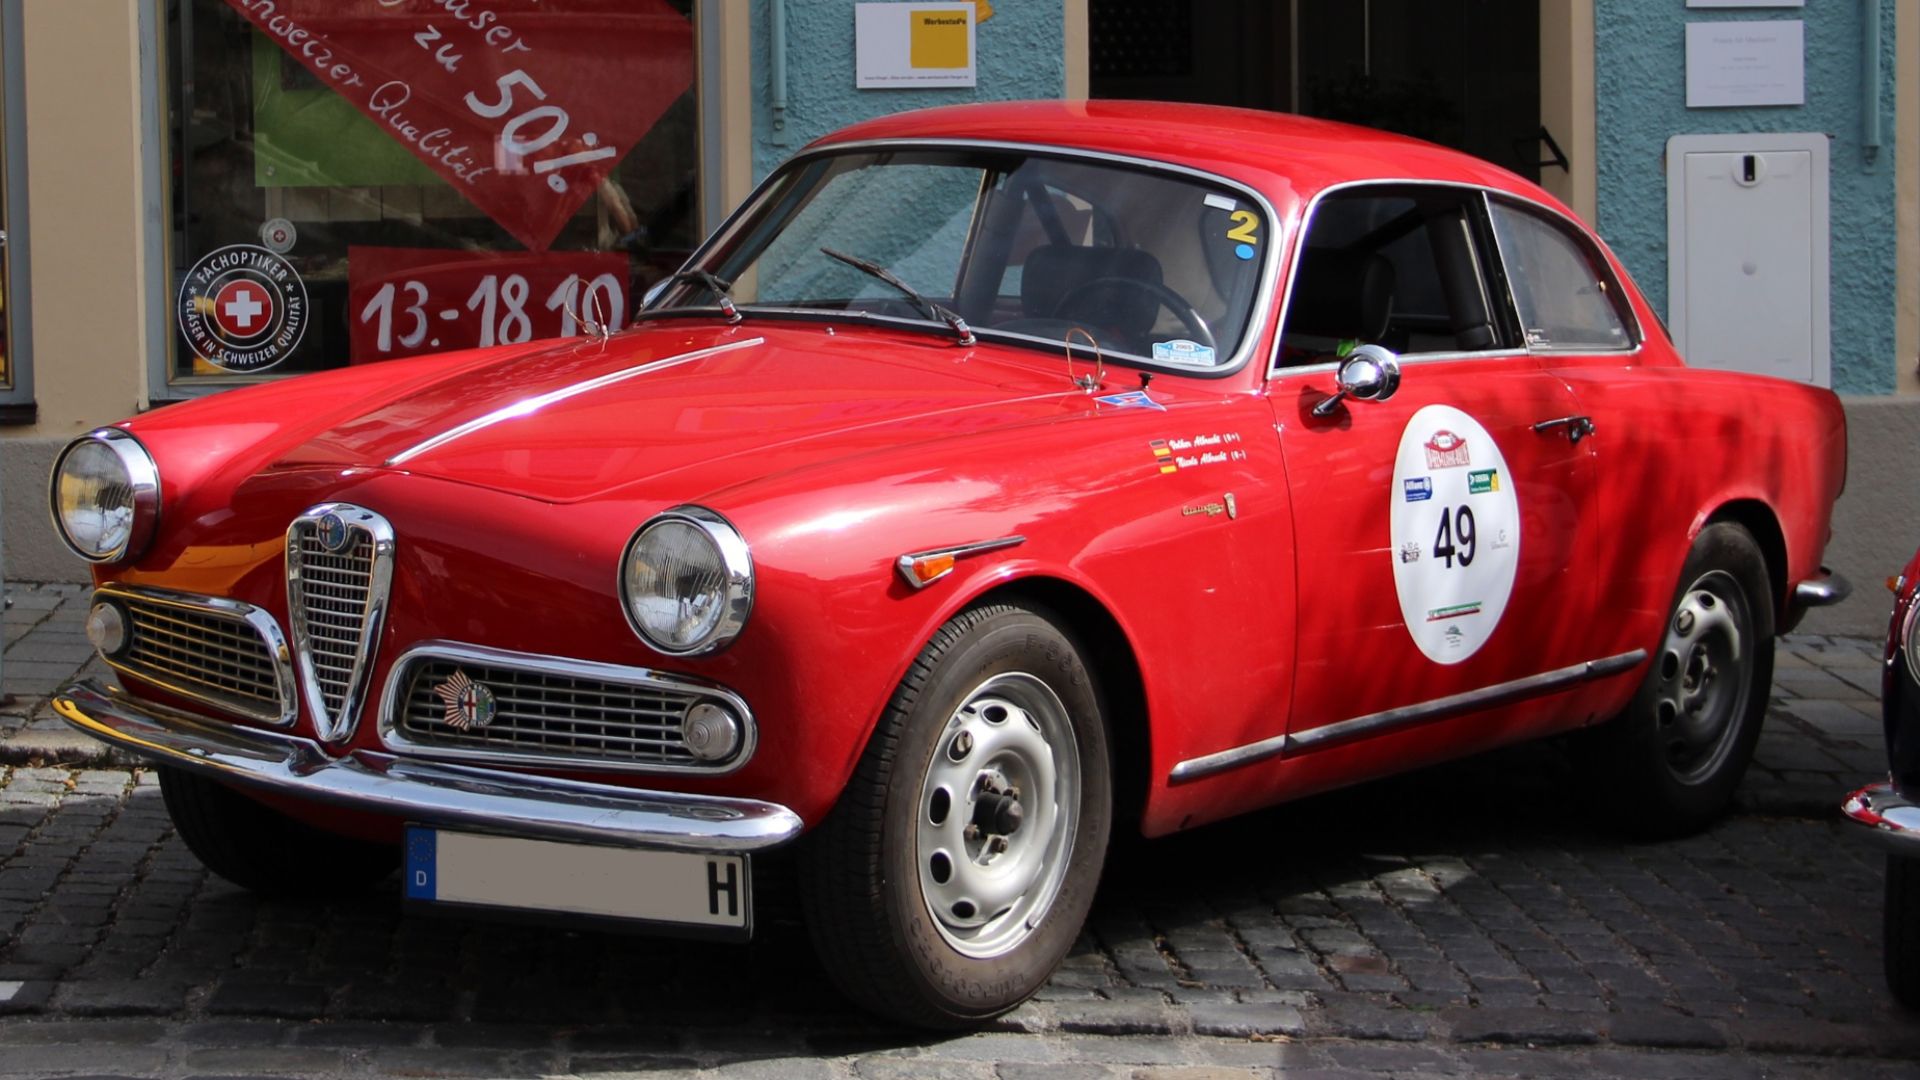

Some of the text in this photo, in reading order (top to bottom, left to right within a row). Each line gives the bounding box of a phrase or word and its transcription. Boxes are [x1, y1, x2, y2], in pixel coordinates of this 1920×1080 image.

[242, 0, 493, 185] weizer Qualität
[414, 24, 617, 193] zu 50%
[1227, 210, 1259, 245] 2
[196, 251, 288, 284] FACHOPTIKER
[186, 296, 301, 365] GLÄSER IN SCHWEIZER QUALITÄT
[1433, 504, 1476, 569] 49
[415, 870, 428, 887] D
[707, 860, 739, 917] H
